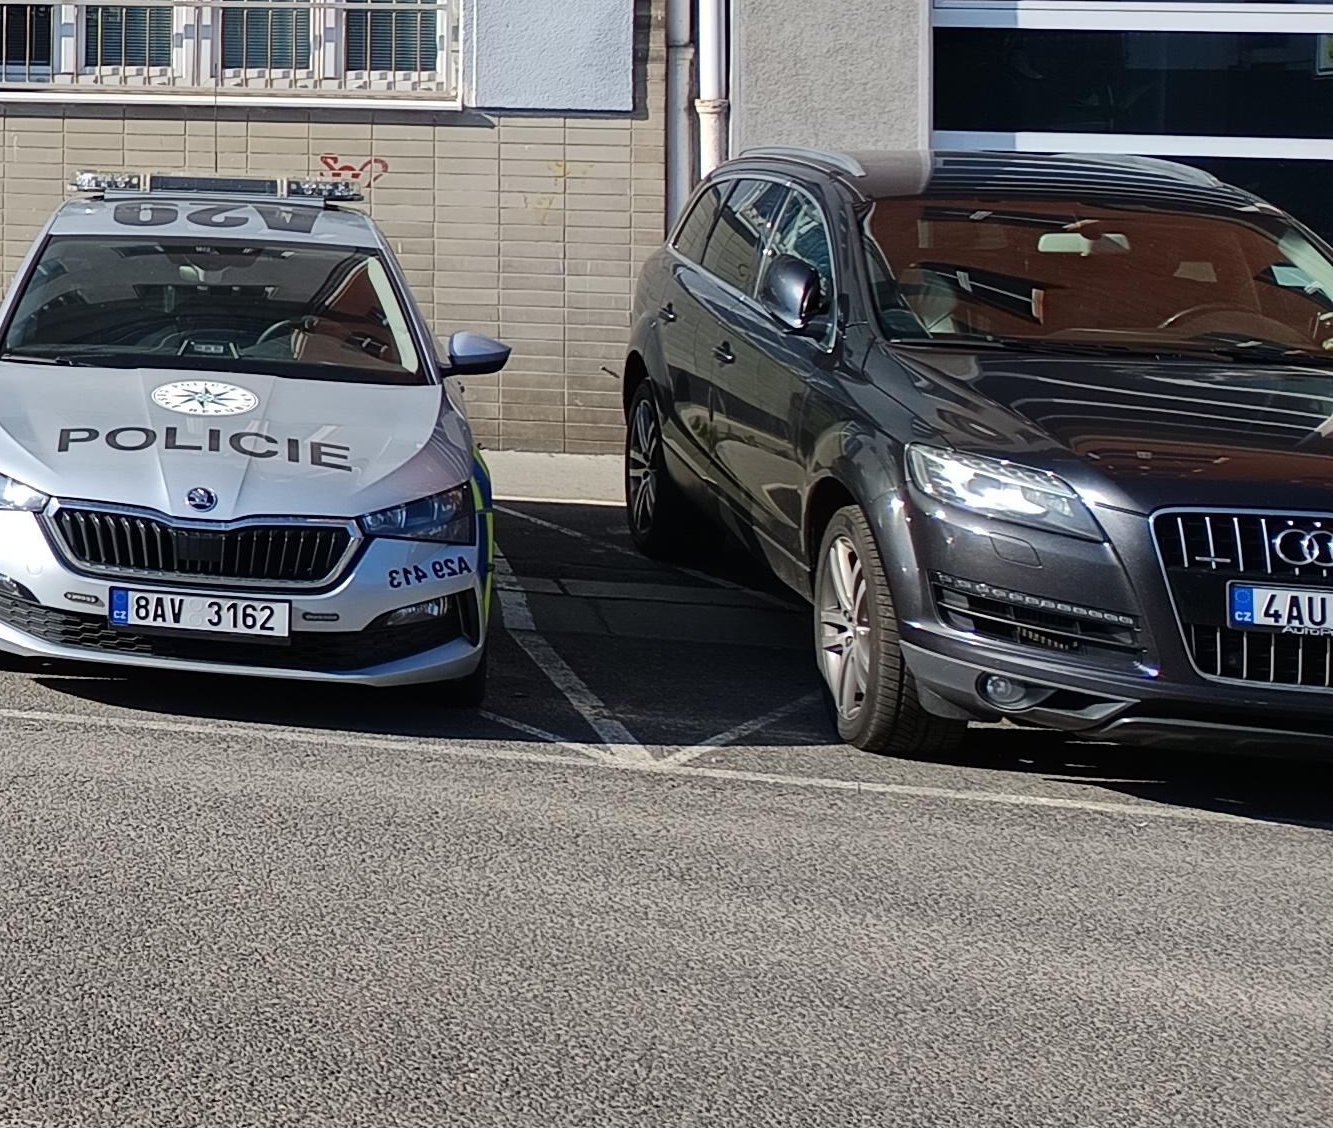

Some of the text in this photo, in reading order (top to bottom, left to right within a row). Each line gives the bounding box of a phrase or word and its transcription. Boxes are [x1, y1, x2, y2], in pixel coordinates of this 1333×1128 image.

[57, 426, 353, 472] POLICIE
[113, 610, 127, 620] CZ
[135, 595, 275, 632] 8AV 3162
[1234, 611, 1252, 622] CZ
[1263, 594, 1327, 626] 4AU
